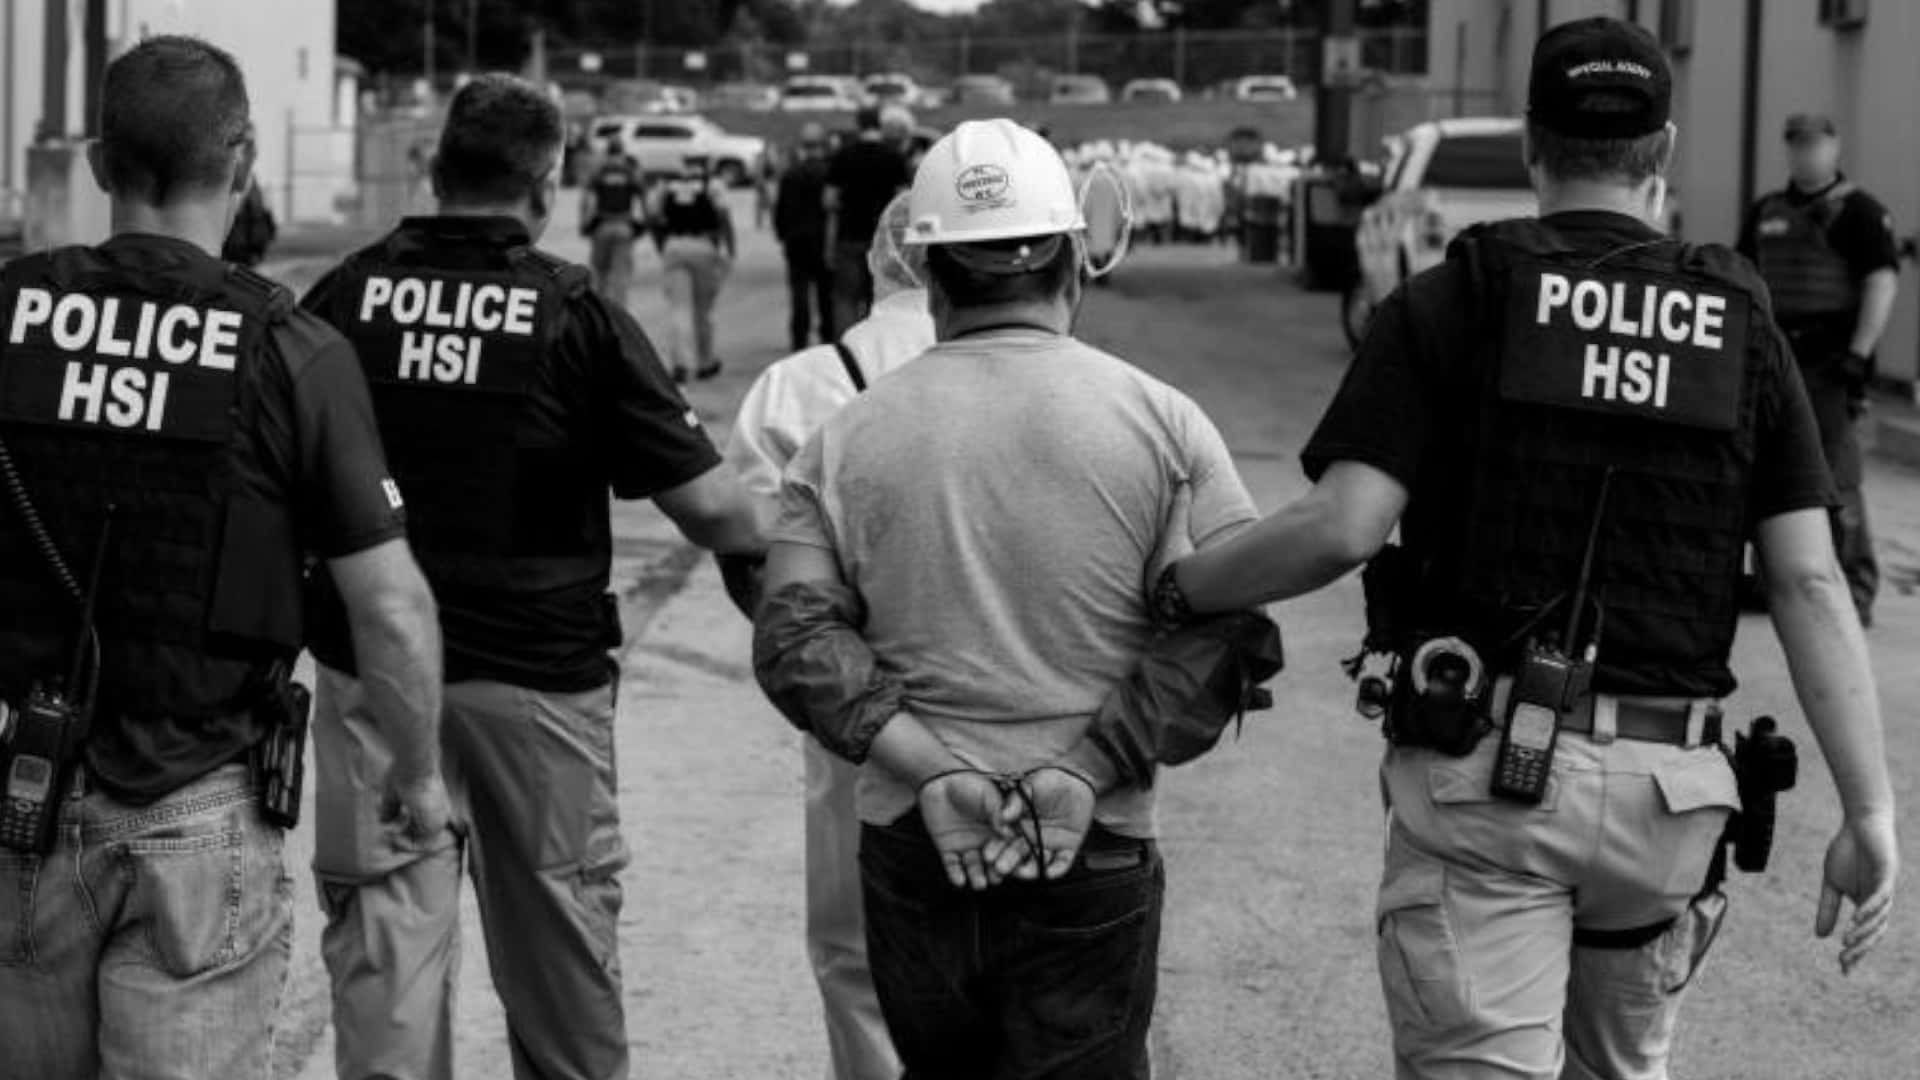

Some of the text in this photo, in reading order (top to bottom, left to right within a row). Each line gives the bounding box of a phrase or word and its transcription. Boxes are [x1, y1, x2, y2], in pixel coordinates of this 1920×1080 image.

[9, 288, 243, 370] POLICE
[360, 277, 538, 334] POLICE
[1537, 273, 1726, 349] POLICE
[398, 331, 482, 384] HSI
[1582, 344, 1670, 408] HSI
[58, 361, 169, 431] HSI
